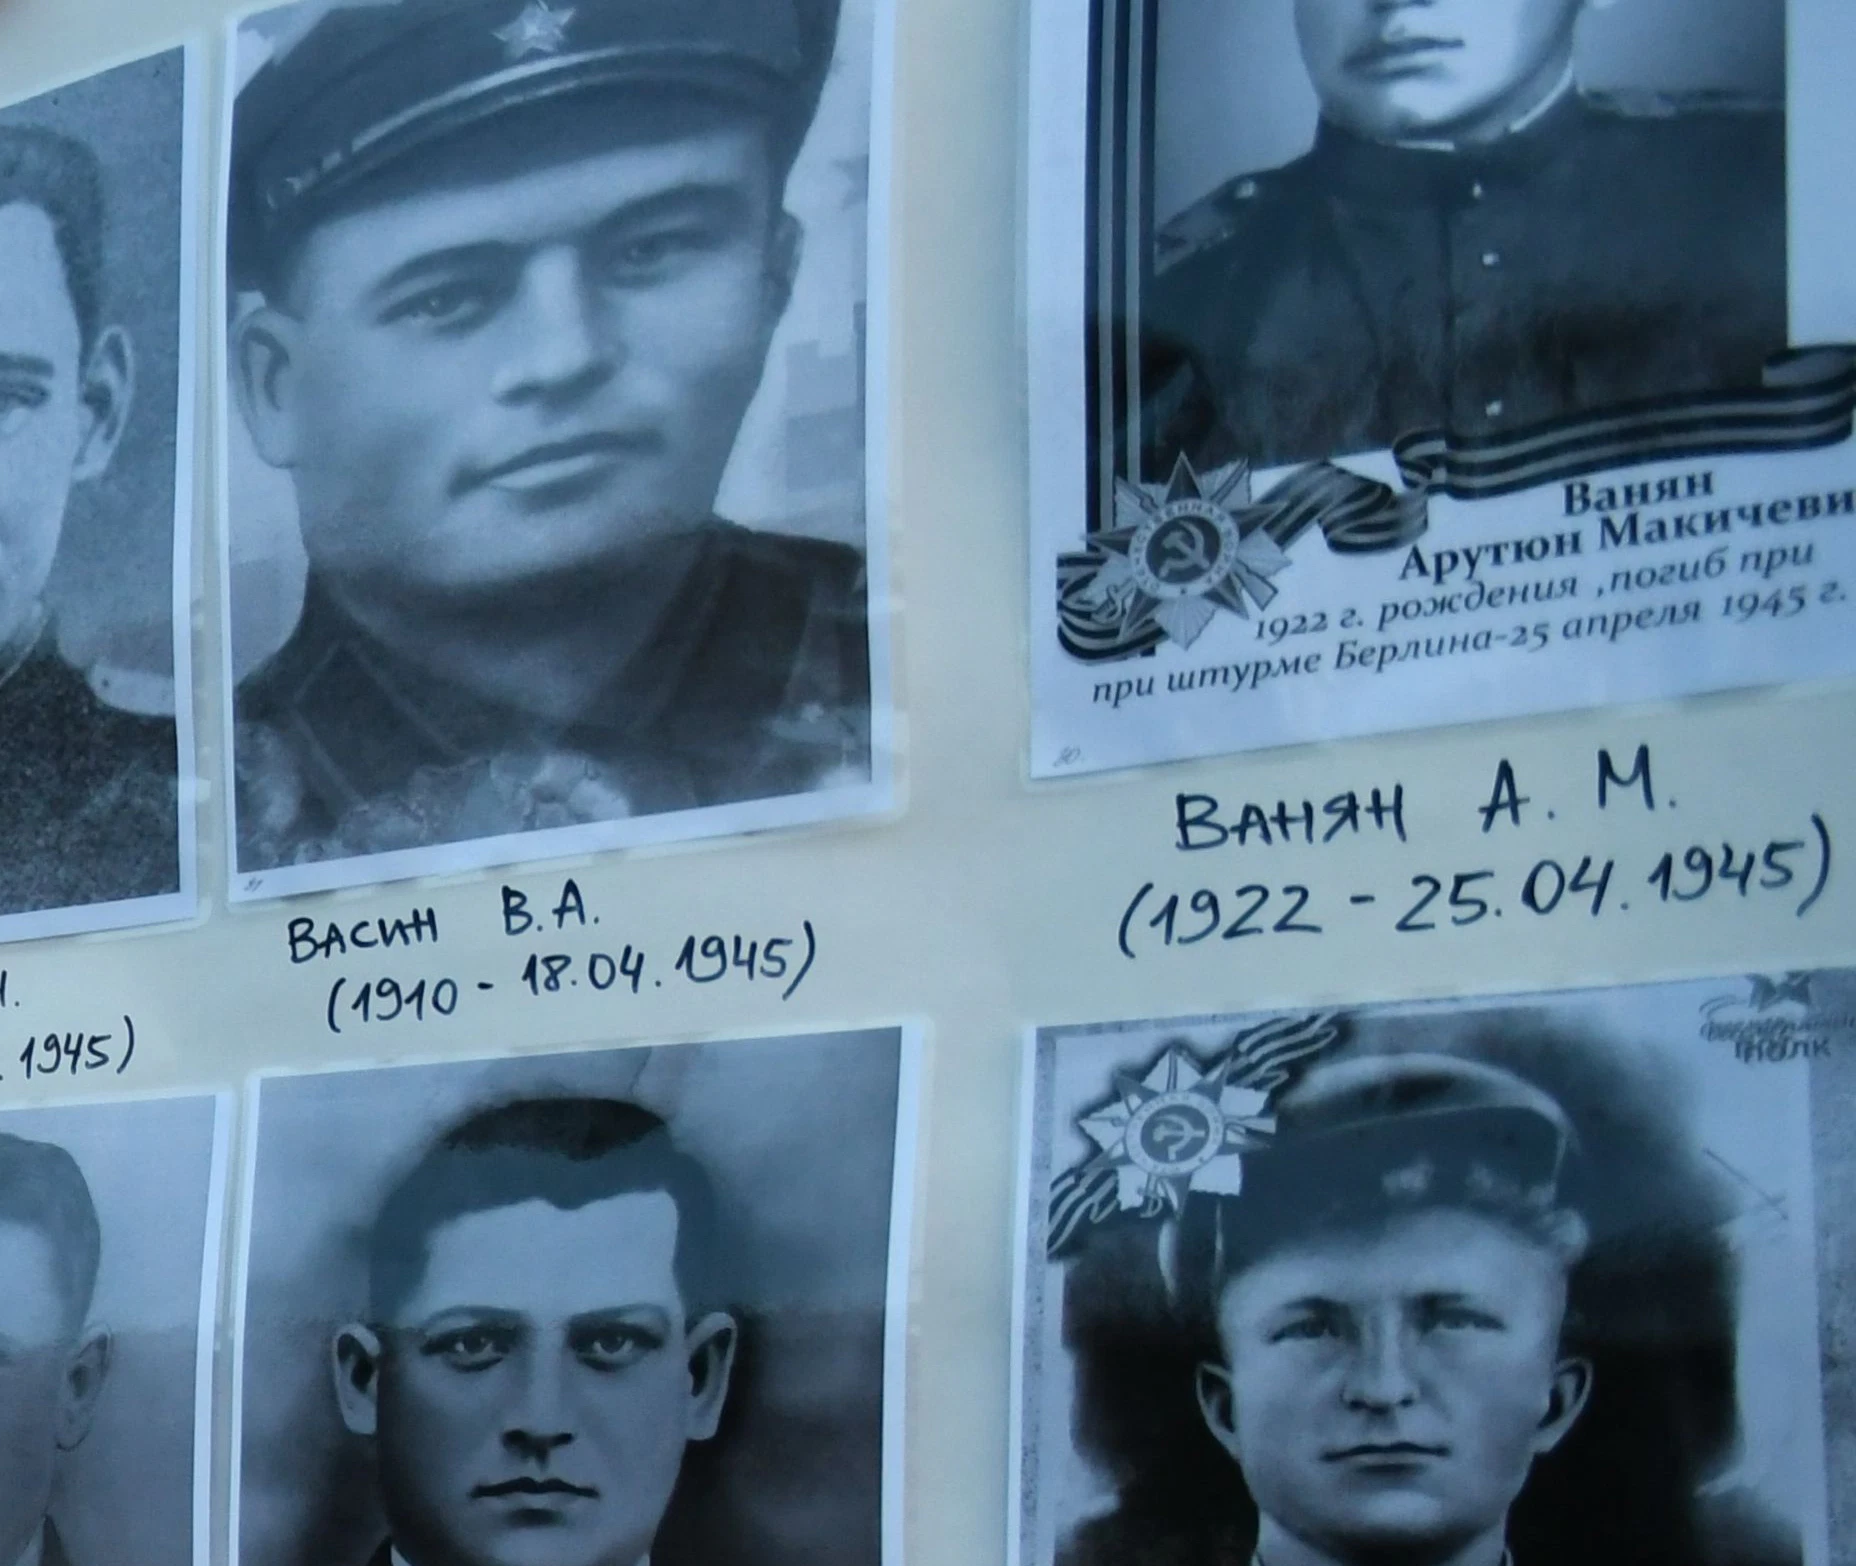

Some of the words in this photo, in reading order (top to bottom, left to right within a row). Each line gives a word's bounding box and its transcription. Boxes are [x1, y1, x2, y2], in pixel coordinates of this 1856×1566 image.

[1562, 470, 1715, 516] Ванян
[1255, 609, 1327, 642] 1922
[1379, 573, 1579, 631] рождения
[1739, 542, 1815, 575] при
[1399, 527, 1585, 581] Арутюн
[1092, 674, 1155, 707] при
[1167, 649, 1323, 699] штурме
[1563, 600, 1701, 643] апреля
[1723, 584, 1807, 623] 1945
